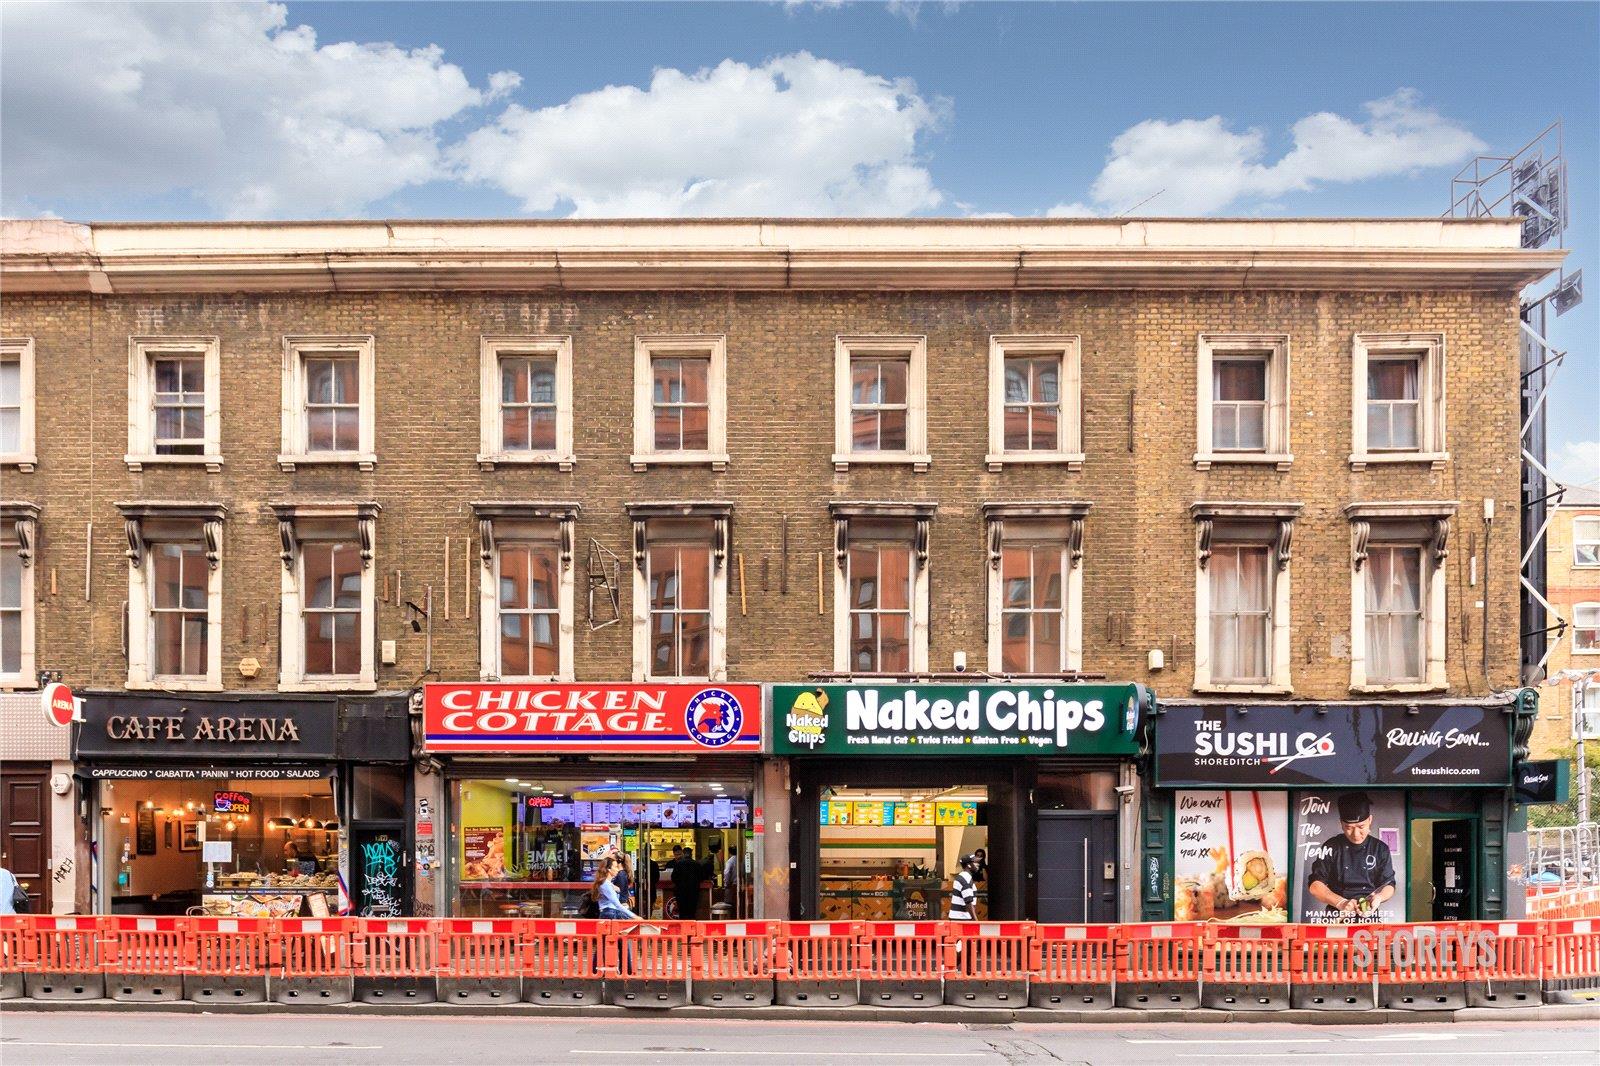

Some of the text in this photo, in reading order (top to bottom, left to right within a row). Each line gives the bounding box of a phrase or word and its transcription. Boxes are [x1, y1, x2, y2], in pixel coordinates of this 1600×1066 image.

[52, 699, 73, 711] ARENA
[441, 690, 668, 710] CHICKEN
[442, 711, 668, 732] COTTAGE
[785, 713, 829, 728] Naked
[846, 689, 980, 731] Naked
[985, 689, 1105, 747] Chips
[193, 716, 300, 742] ARENA
[1193, 720, 1222, 731] THE
[788, 730, 826, 750] Chips
[847, 735, 1053, 747] Fresh Hand Cut Twice Fried Gluten Free Vegan
[1194, 731, 1288, 756] SUSHI
[1194, 757, 1261, 766] SHOREDITCH
[92, 769, 320, 778] CAPPUCCINO CIABATTA PANINI HOT FOOD SALADS
[1411, 766, 1480, 775] thesushico.com
[229, 803, 250, 813] OPEN
[528, 797, 553, 807] OPEN
[1180, 796, 1198, 810] We
[906, 901, 928, 909] Naked
[907, 911, 927, 919] Chips
[1305, 910, 1356, 918] MANAGERS
